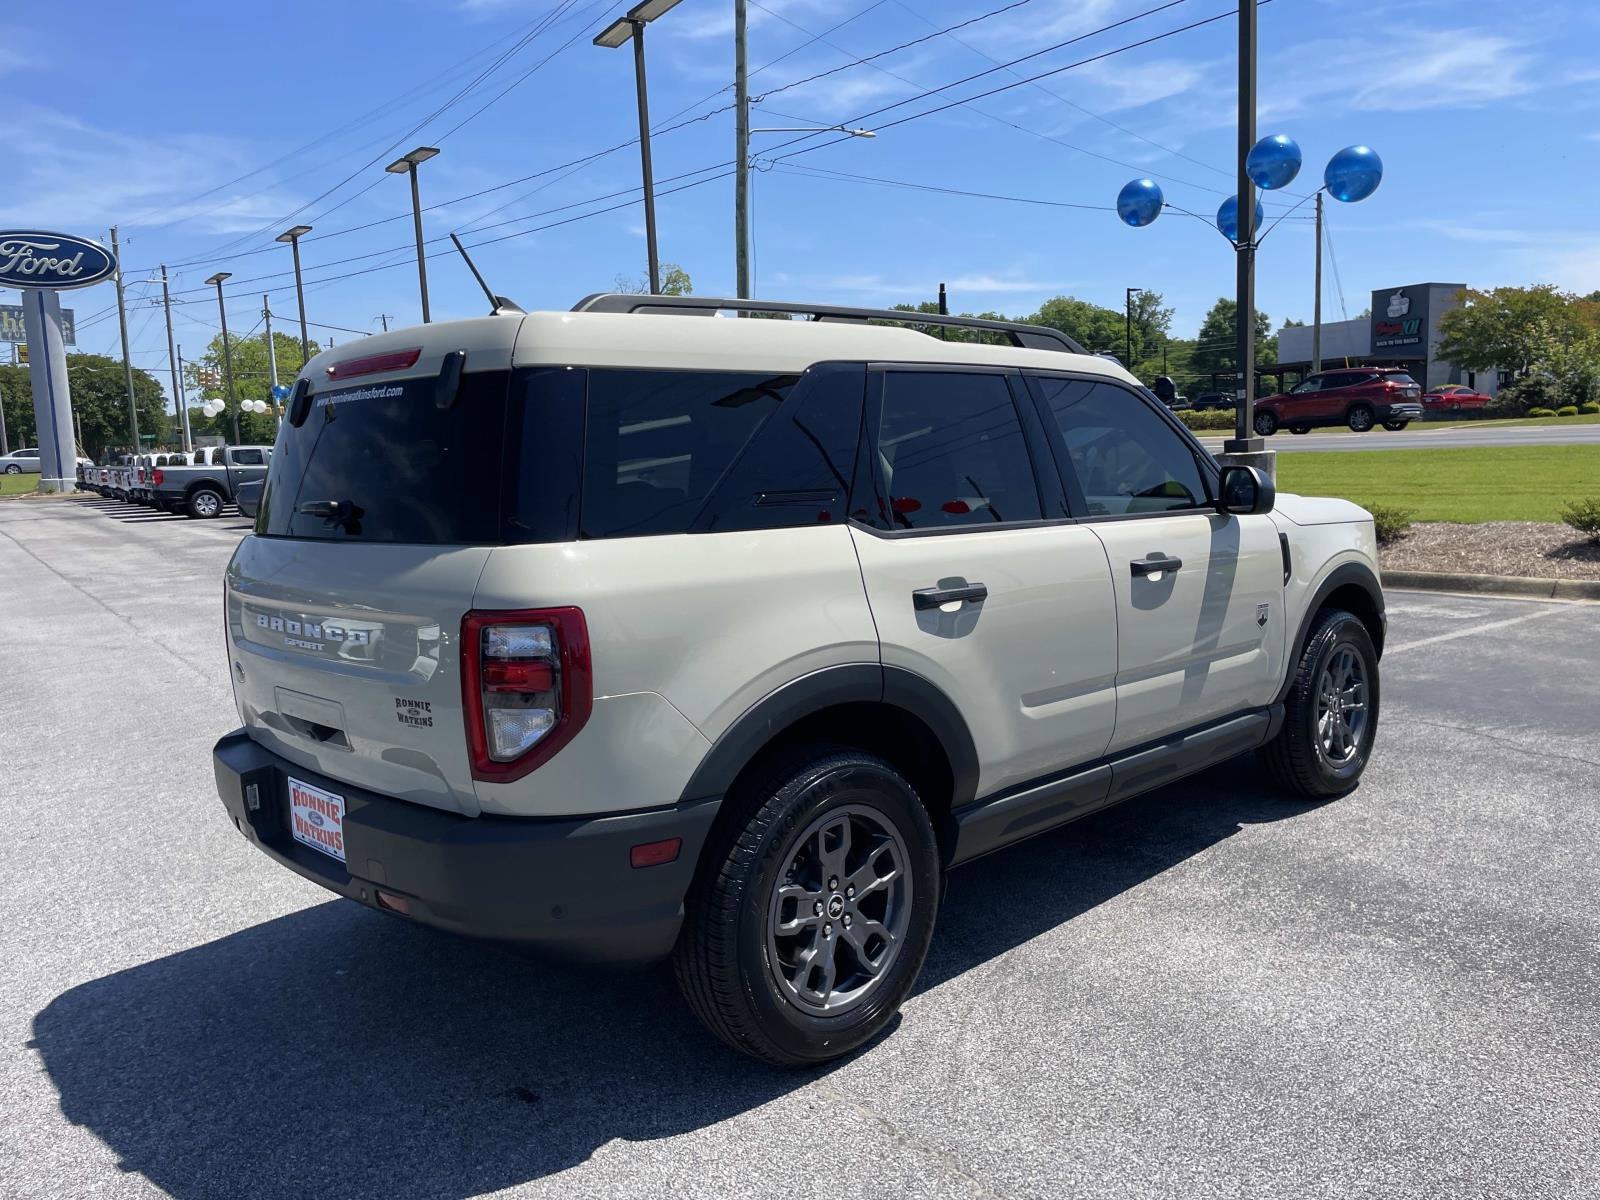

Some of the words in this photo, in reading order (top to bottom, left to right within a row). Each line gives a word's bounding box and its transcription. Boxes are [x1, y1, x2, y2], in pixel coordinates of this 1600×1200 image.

[0, 240, 84, 276] Ford
[257, 613, 369, 645] BRONCO
[284, 637, 326, 651] SPORT
[395, 698, 432, 713] RONNIE
[397, 711, 433, 728] WATKINS
[292, 788, 340, 826] RONNIE
[294, 812, 343, 851] WATKINS
